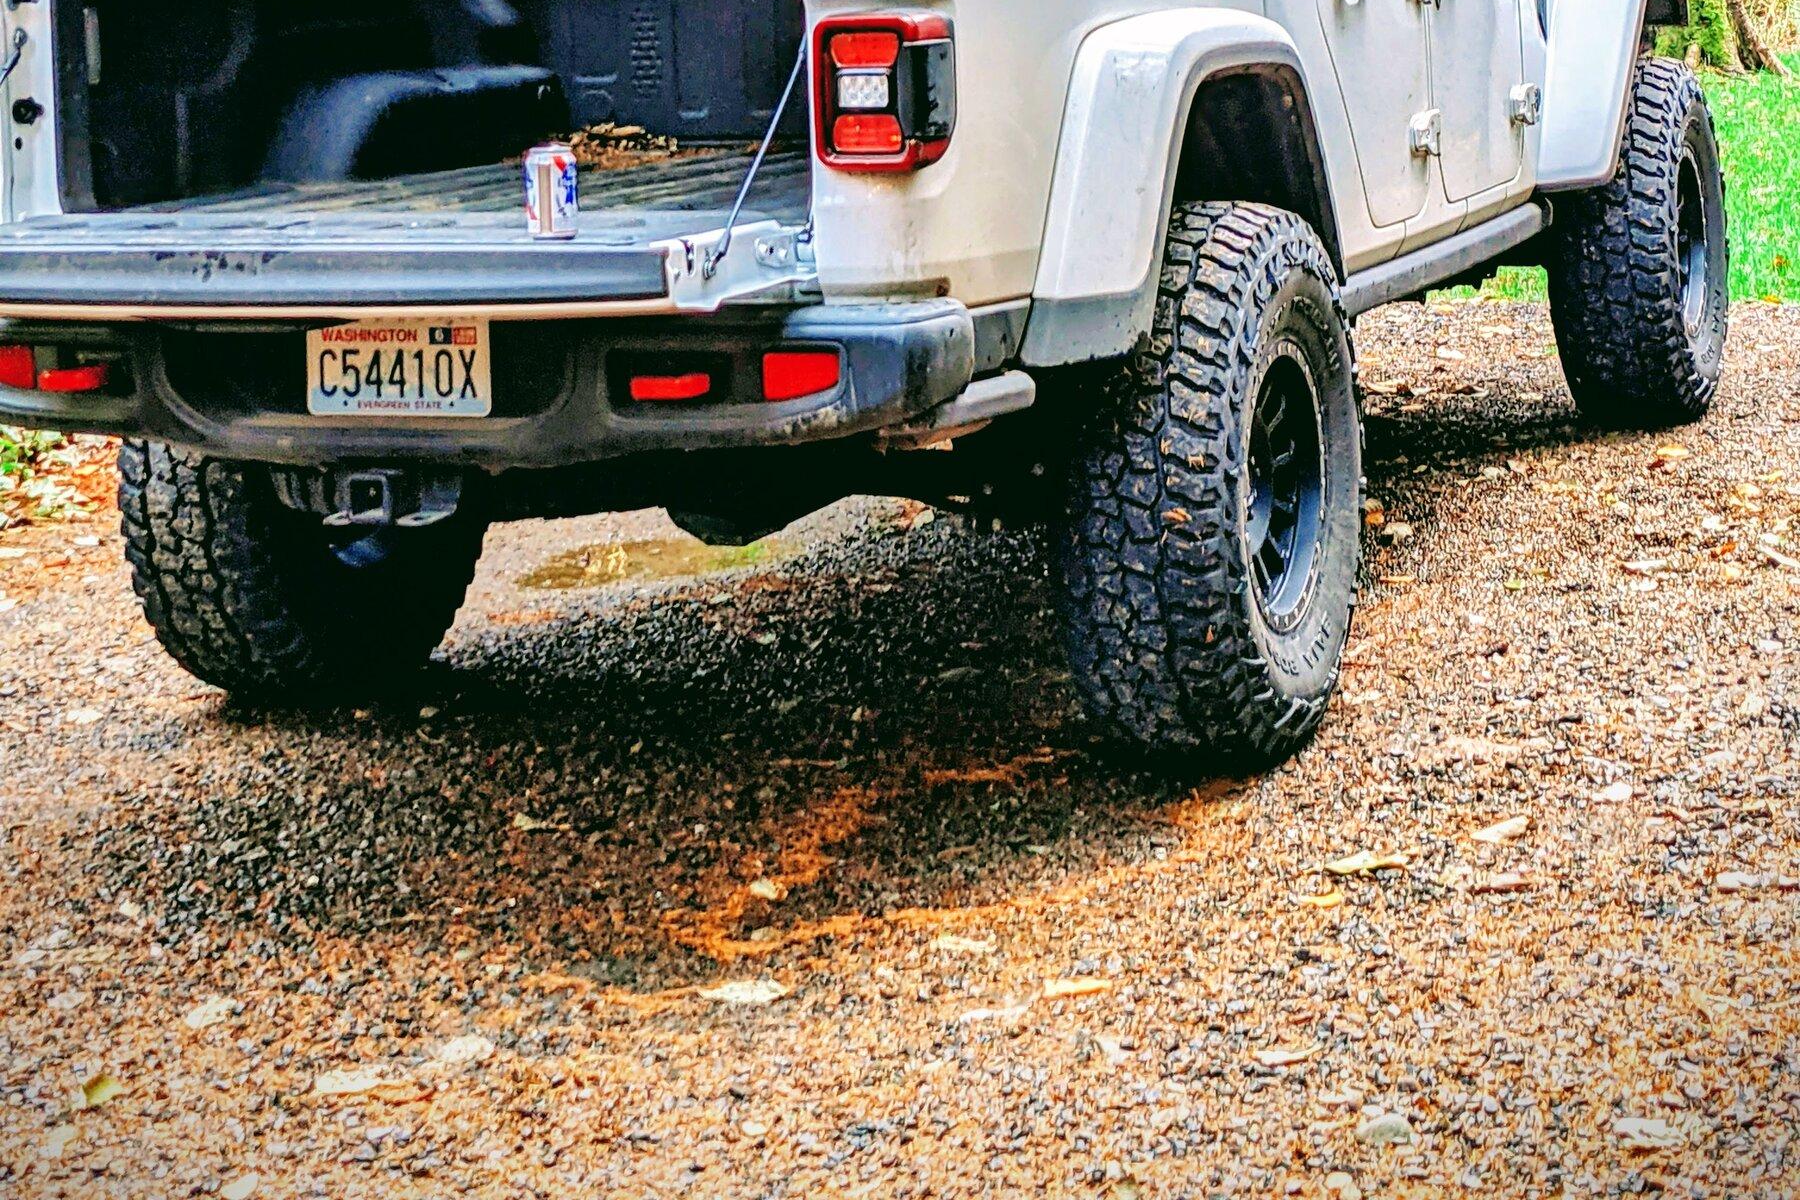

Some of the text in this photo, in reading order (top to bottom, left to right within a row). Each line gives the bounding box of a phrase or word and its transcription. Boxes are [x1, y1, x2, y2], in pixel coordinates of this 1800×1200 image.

[321, 328, 418, 343] WASHINGTON
[319, 348, 478, 399] C54410X
[357, 400, 442, 409] EVERGREEN STATE
